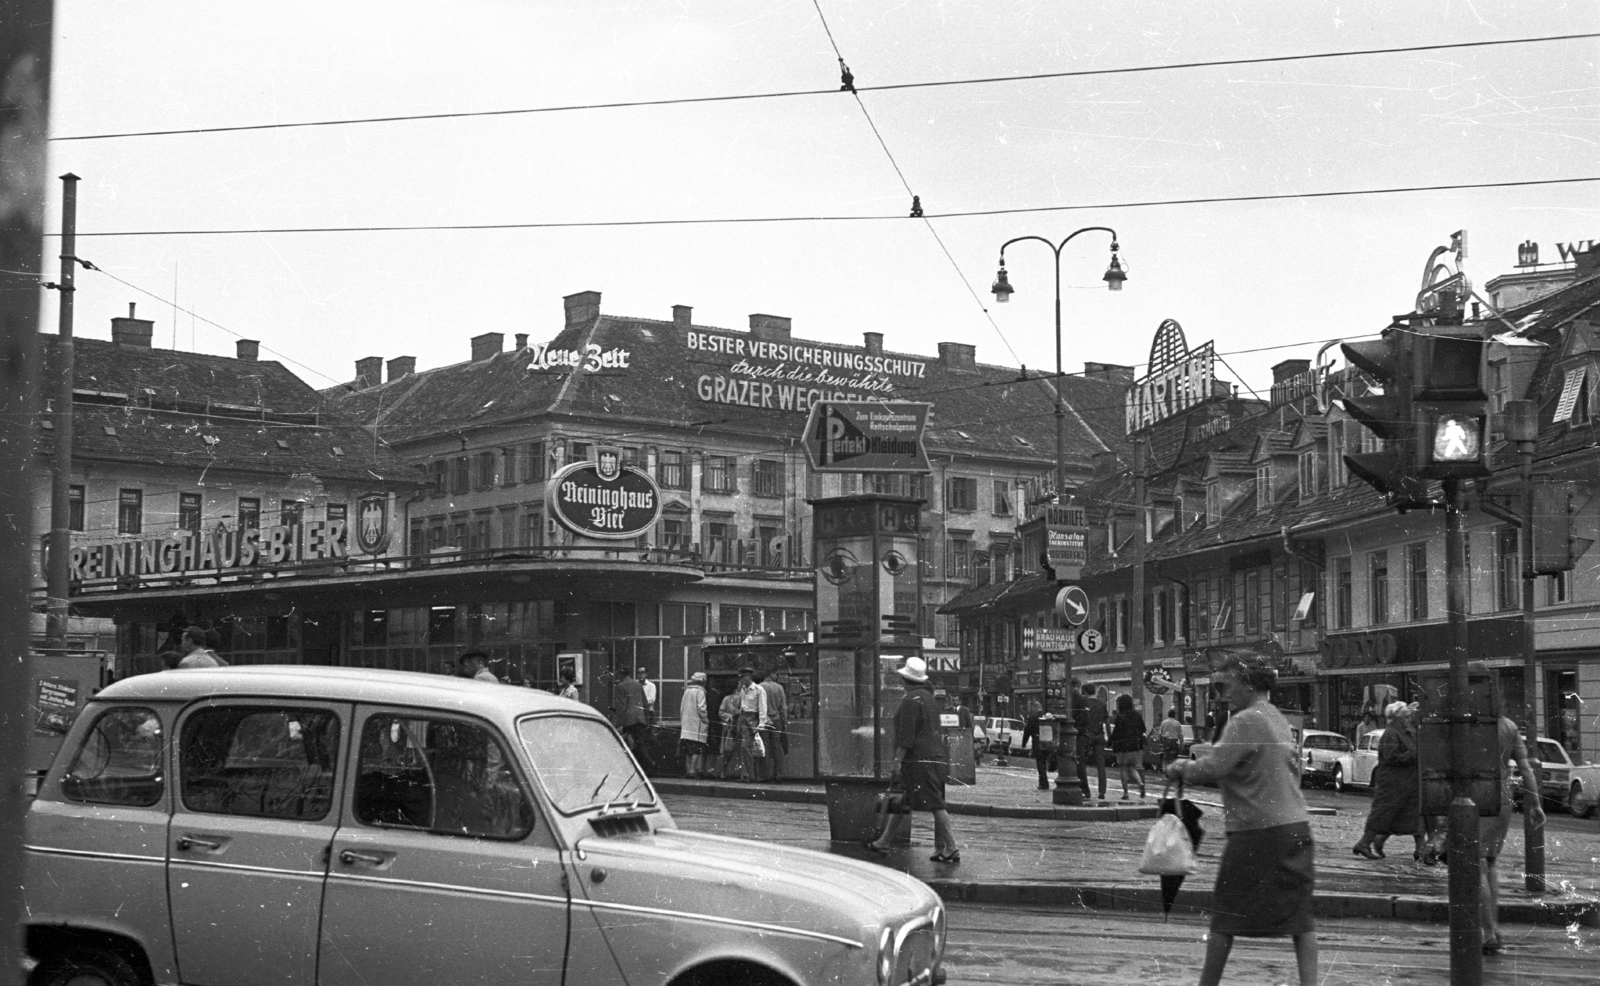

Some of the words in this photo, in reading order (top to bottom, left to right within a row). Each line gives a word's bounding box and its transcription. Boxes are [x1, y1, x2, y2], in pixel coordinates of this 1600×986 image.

[527, 342, 580, 370] Neue
[583, 343, 631, 372] Zeit
[688, 331, 745, 356] BESTER
[748, 340, 926, 378] VERSICHERUNGSSCHUTZ
[730, 358, 785, 378] durch
[786, 365, 813, 382] die
[815, 368, 893, 392] bewährte
[697, 375, 772, 409] GRAZER
[1126, 347, 1212, 435] MARTINI
[855, 411, 868, 421] Zum
[871, 437, 917, 457] Kleidung
[561, 481, 653, 510] Reininghaus
[591, 506, 625, 529] Bier
[885, 509, 897, 528] H
[71, 519, 347, 582] REININGHAUS-BIER
[1036, 641, 1076, 650] PUNTIGAM
[1088, 636, 1096, 650] 5
